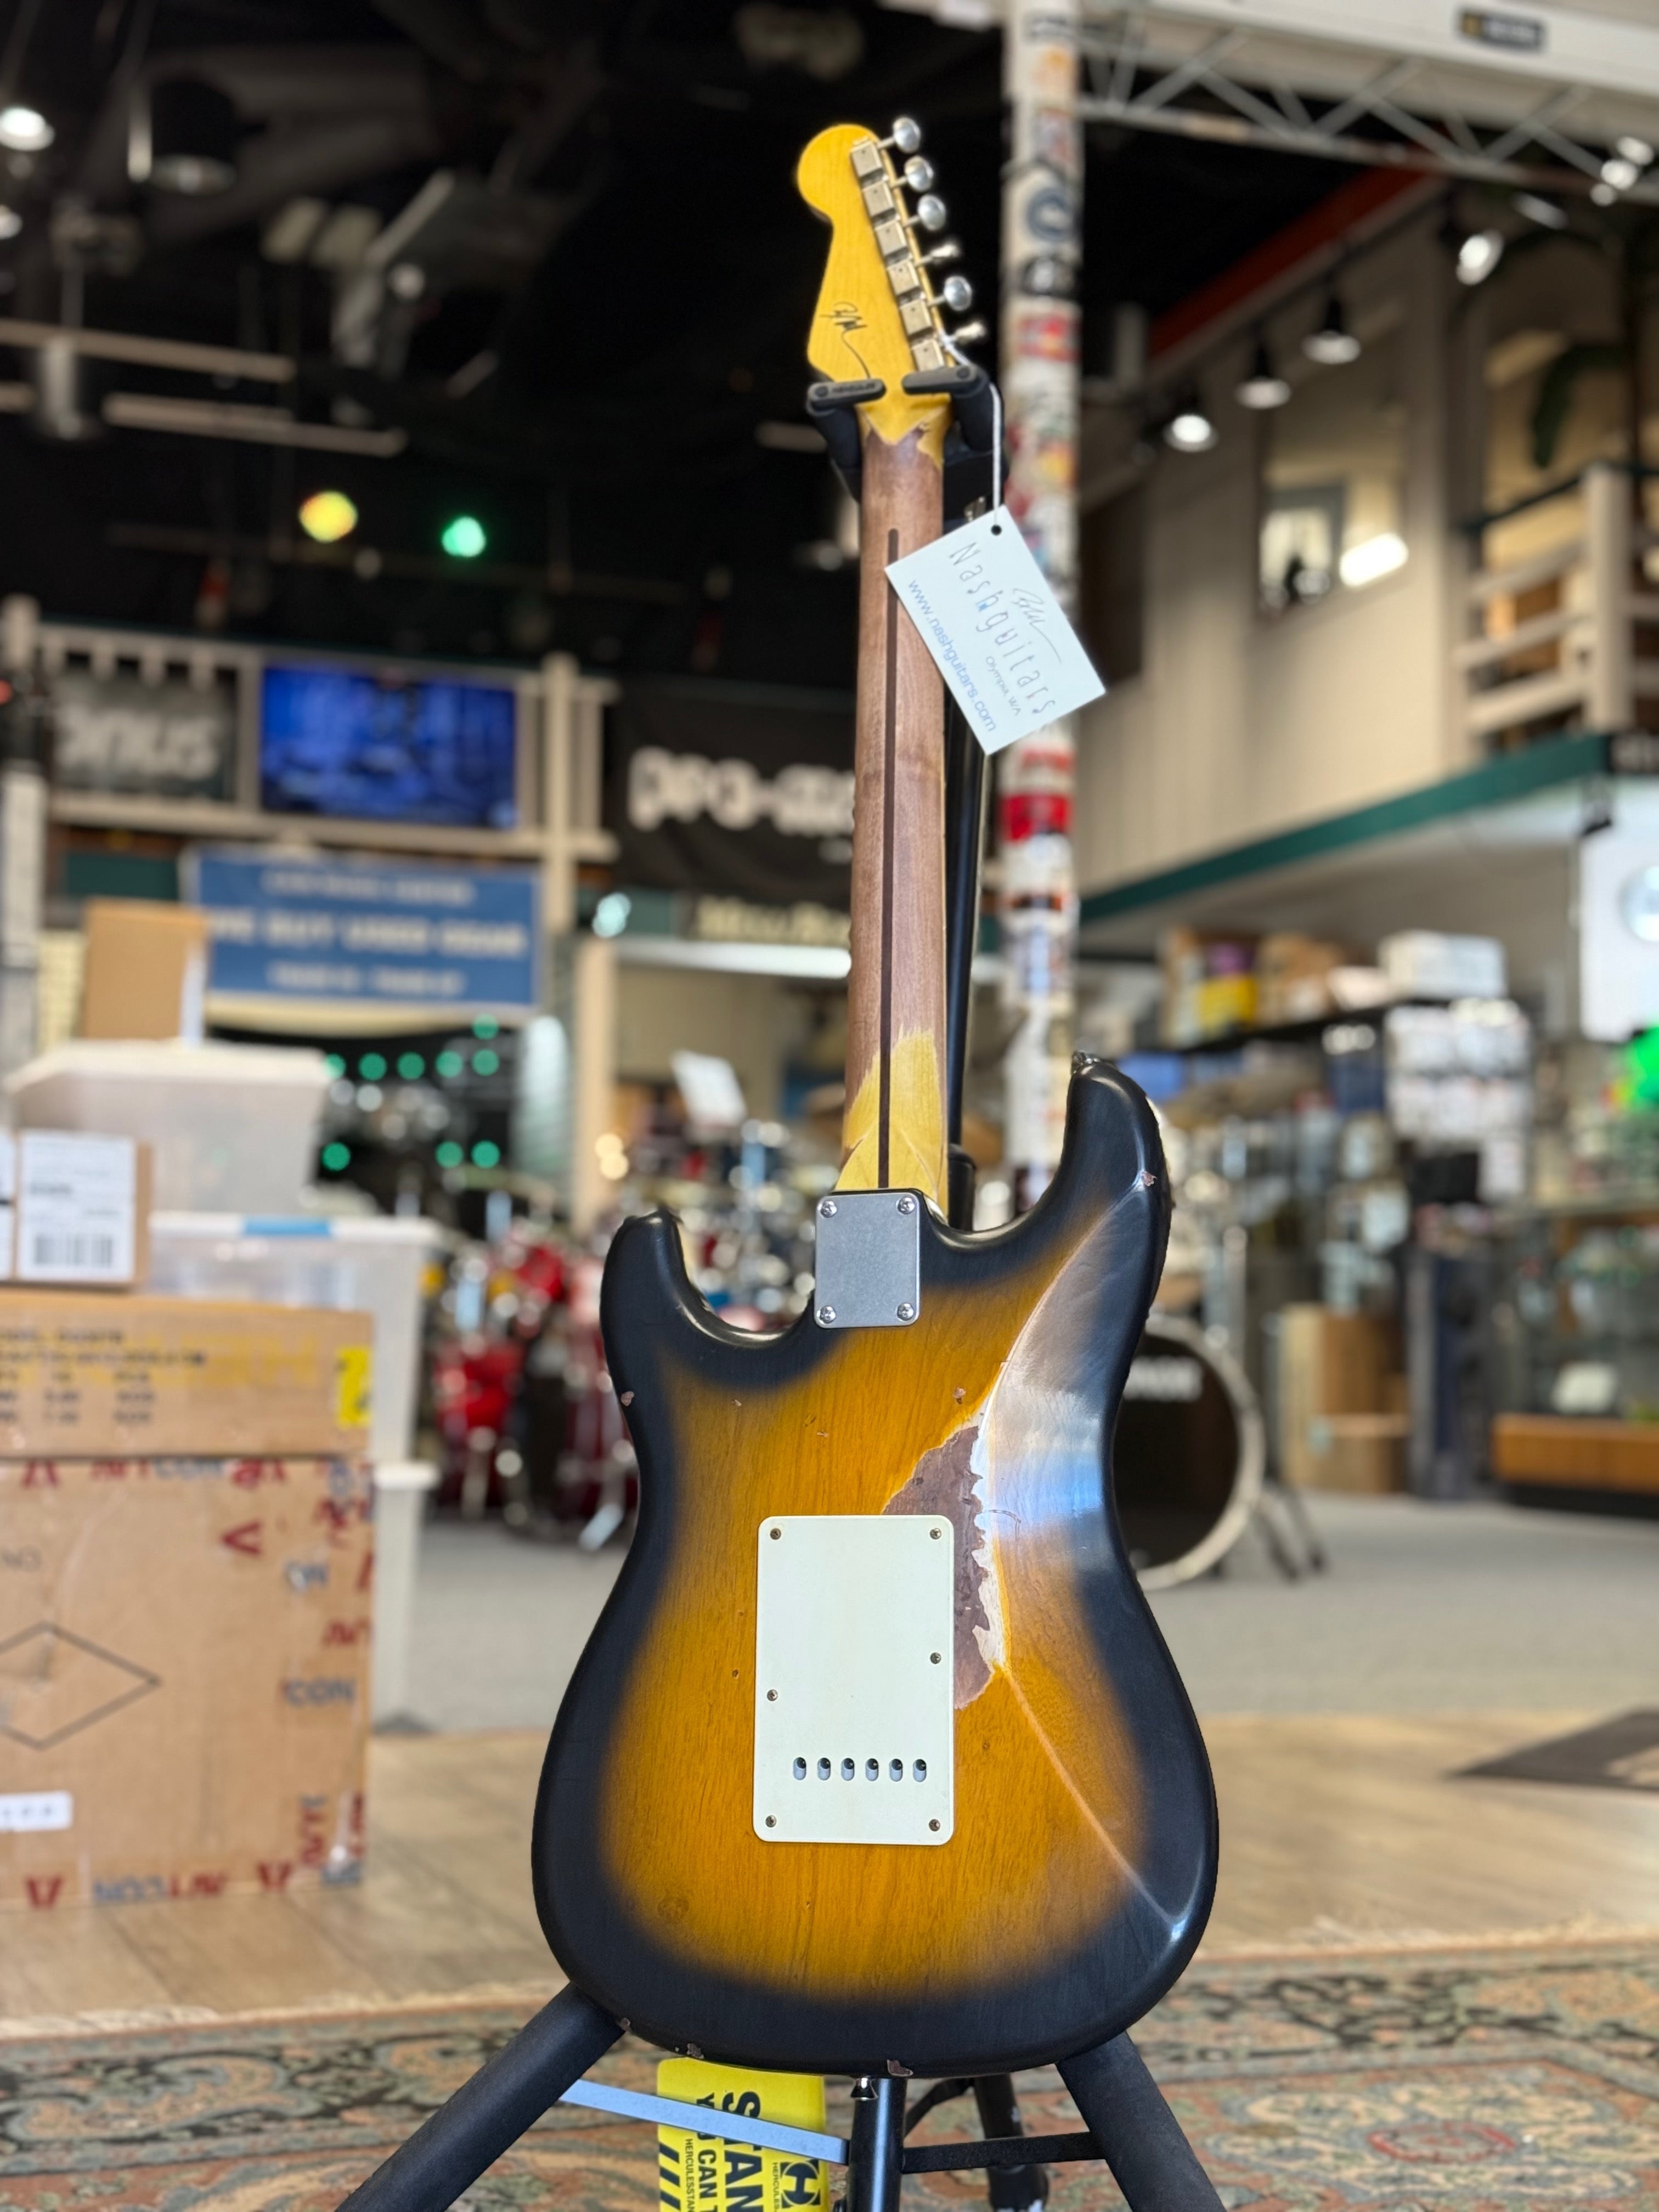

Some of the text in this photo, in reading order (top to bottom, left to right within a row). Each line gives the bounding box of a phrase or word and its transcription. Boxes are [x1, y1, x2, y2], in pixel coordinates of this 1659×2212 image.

[909, 579, 996, 732] www.nashguitars.com
[949, 541, 1057, 715] Nashguitars
[985, 656, 1022, 715] Olympia, WA
[698, 2149, 718, 2199] CAN
